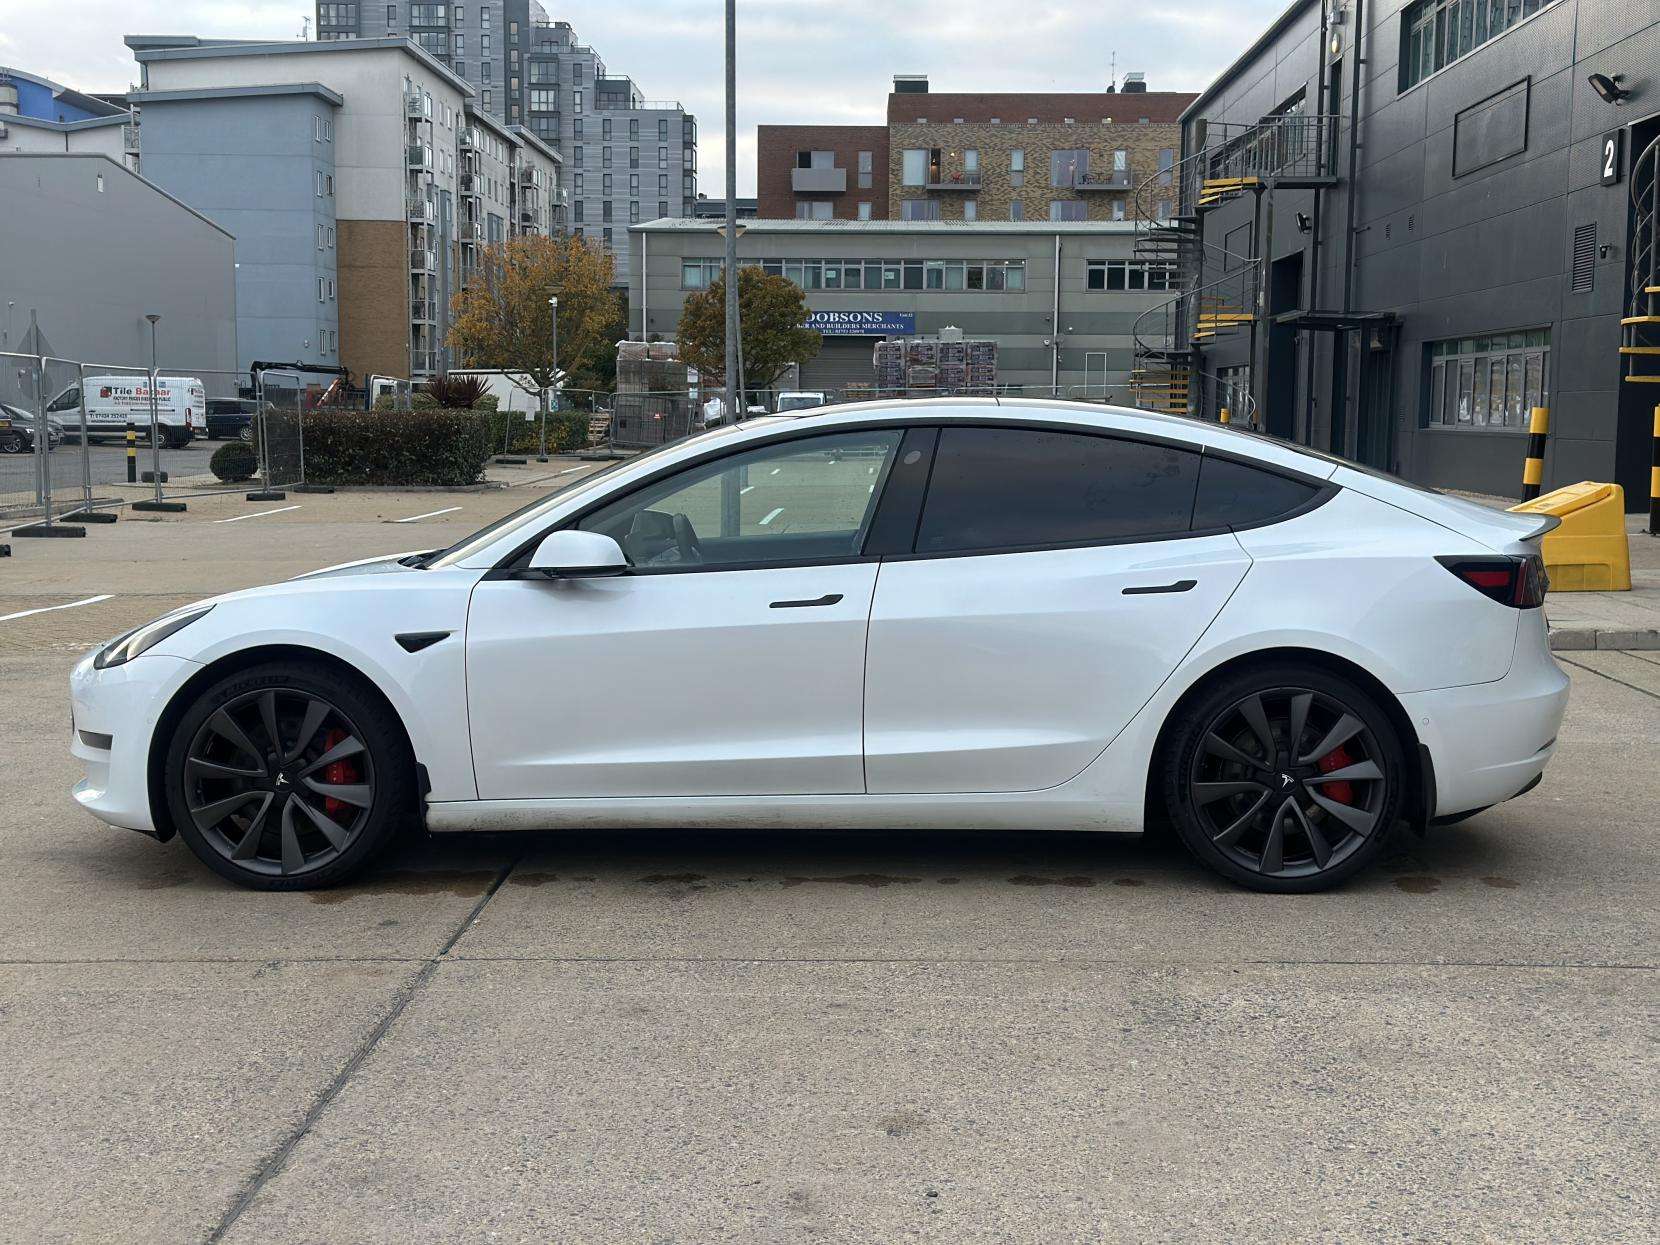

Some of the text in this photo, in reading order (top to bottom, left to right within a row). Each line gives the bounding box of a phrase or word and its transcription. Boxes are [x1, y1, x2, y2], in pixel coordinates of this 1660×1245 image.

[1604, 139, 1614, 178] 2
[113, 387, 171, 395] Tile Baaar
